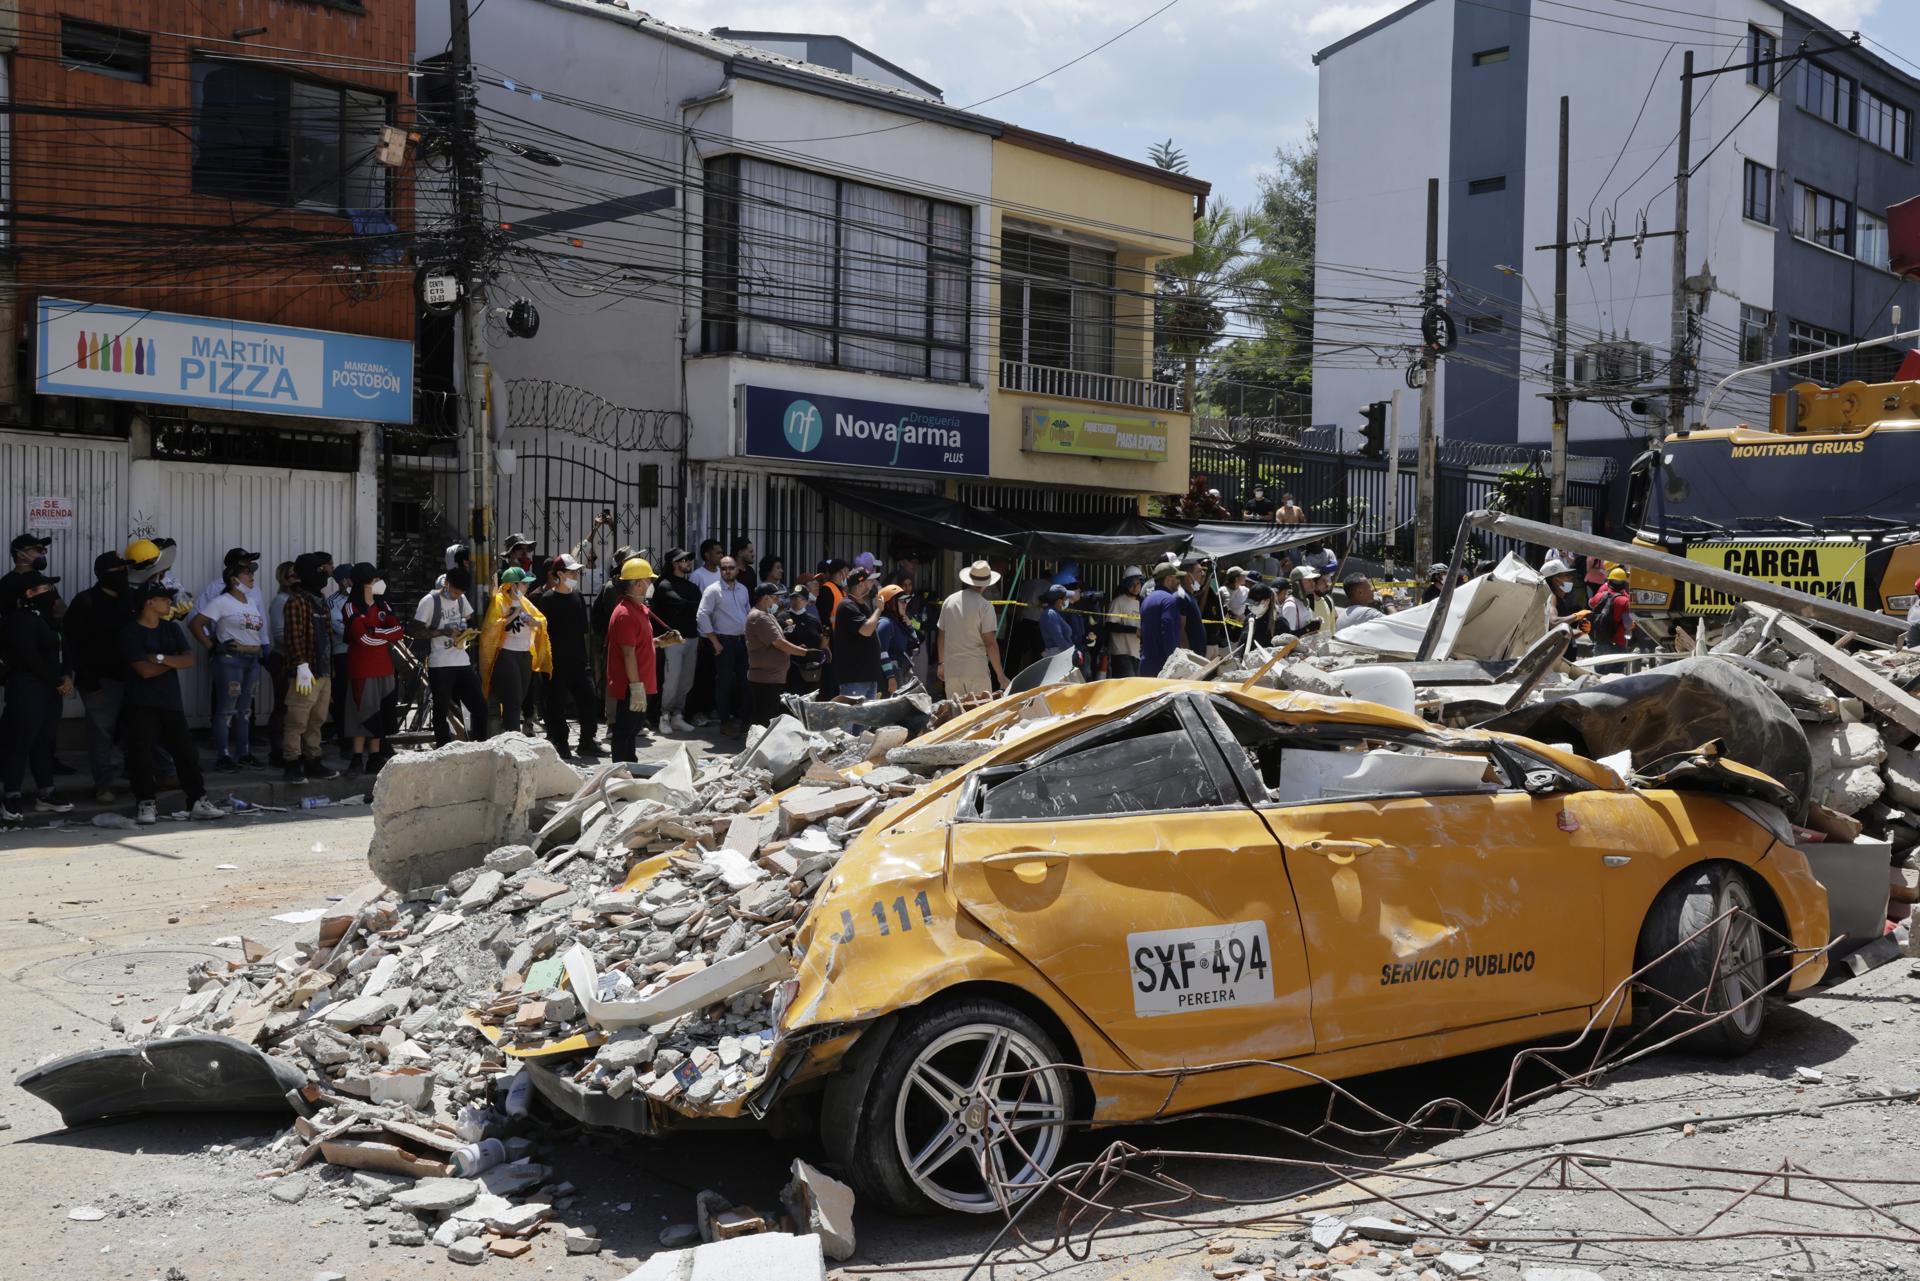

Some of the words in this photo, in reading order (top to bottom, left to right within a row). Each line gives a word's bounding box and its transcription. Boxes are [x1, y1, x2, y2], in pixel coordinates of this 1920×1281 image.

[191, 335, 285, 366] MARTÍN
[180, 357, 299, 401] PIZZA
[344, 361, 385, 374] MANZANA
[835, 413, 961, 466] Novafarma
[1731, 443, 1808, 459] MOVITRAM
[1812, 441, 1865, 455] GRUAS
[942, 452, 965, 464] PLUS
[30, 508, 73, 518] ARRIENDA
[43, 500, 60, 509] SE
[1724, 549, 1820, 577] CARGA
[871, 890, 934, 936] 111
[1134, 942, 1196, 993] SXF
[1212, 935, 1267, 985] 494
[1380, 957, 1460, 986] SERVICIO
[1464, 950, 1536, 978] PUBLICO
[1178, 988, 1236, 1007] PEREIRA
